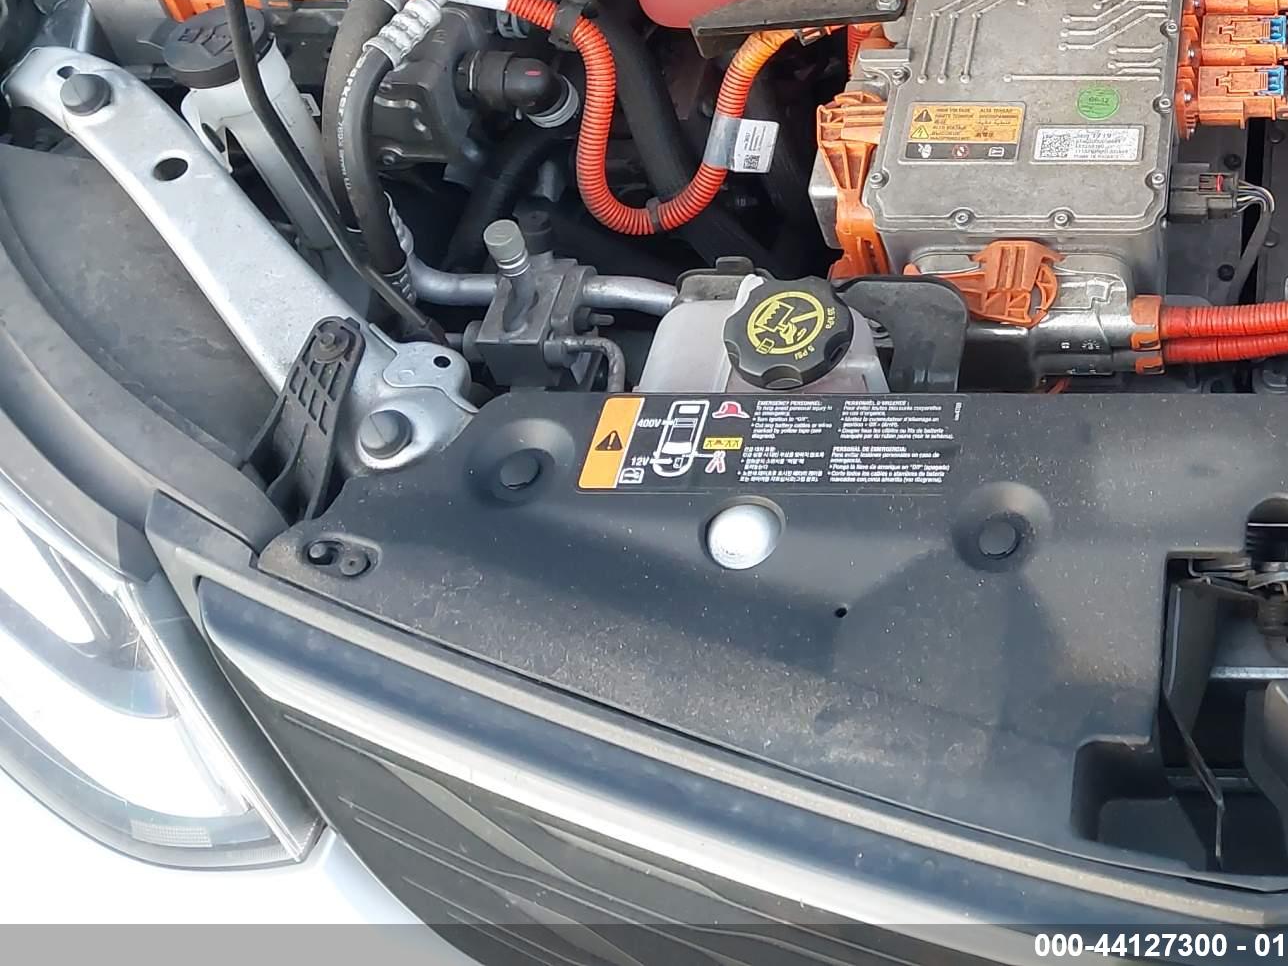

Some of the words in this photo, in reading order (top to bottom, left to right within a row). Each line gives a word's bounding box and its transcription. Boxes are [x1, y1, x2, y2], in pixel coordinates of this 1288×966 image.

[794, 350, 808, 360] PSI
[637, 418, 661, 428] 400V
[631, 457, 650, 466] 12V
